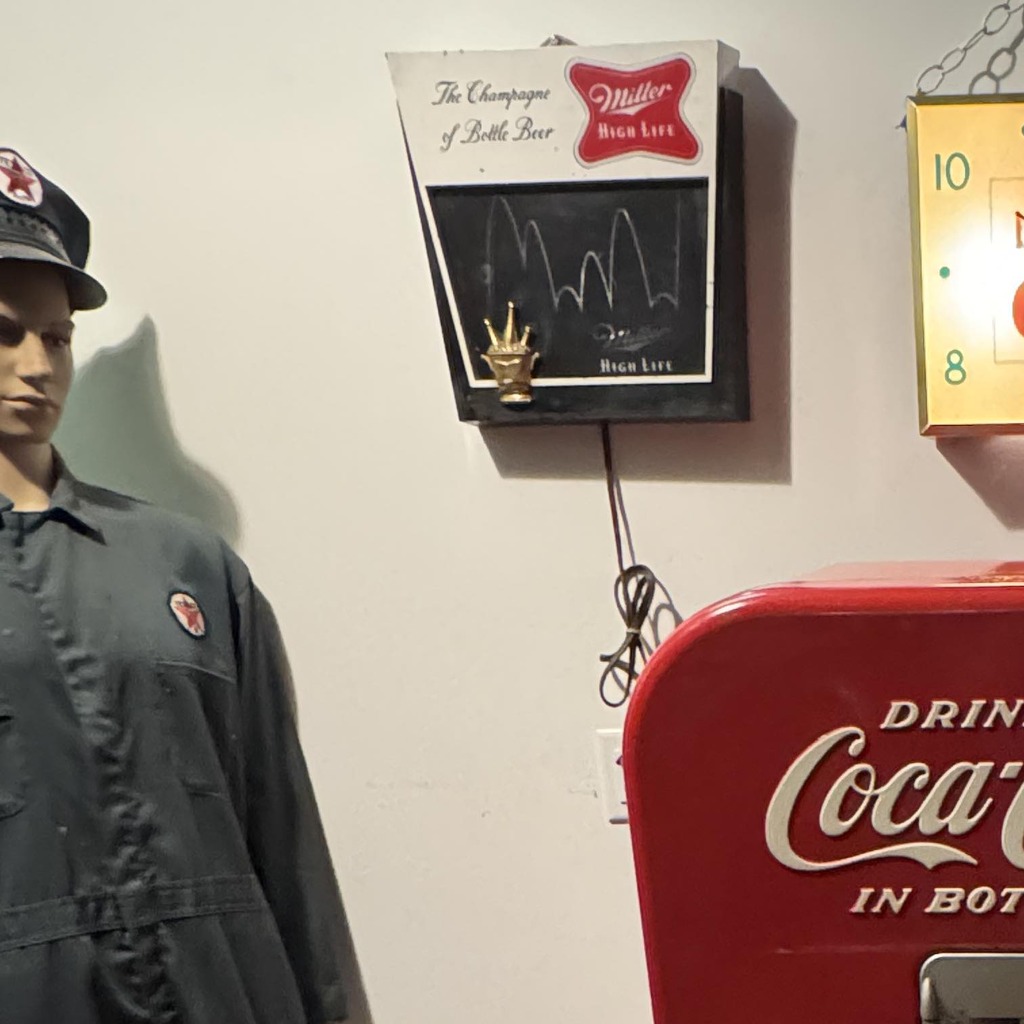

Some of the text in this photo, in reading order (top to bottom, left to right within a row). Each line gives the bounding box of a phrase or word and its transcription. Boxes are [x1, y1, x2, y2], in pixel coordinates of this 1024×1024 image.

[431, 79, 551, 110] The Champagne
[589, 80, 673, 115] Miller
[440, 116, 555, 152] of Bottle Beer
[598, 120, 675, 139] HIGH LIFE
[935, 152, 970, 190] 10
[600, 358, 637, 373] HIGH
[944, 349, 967, 386] 8
[849, 886, 912, 914] IN
